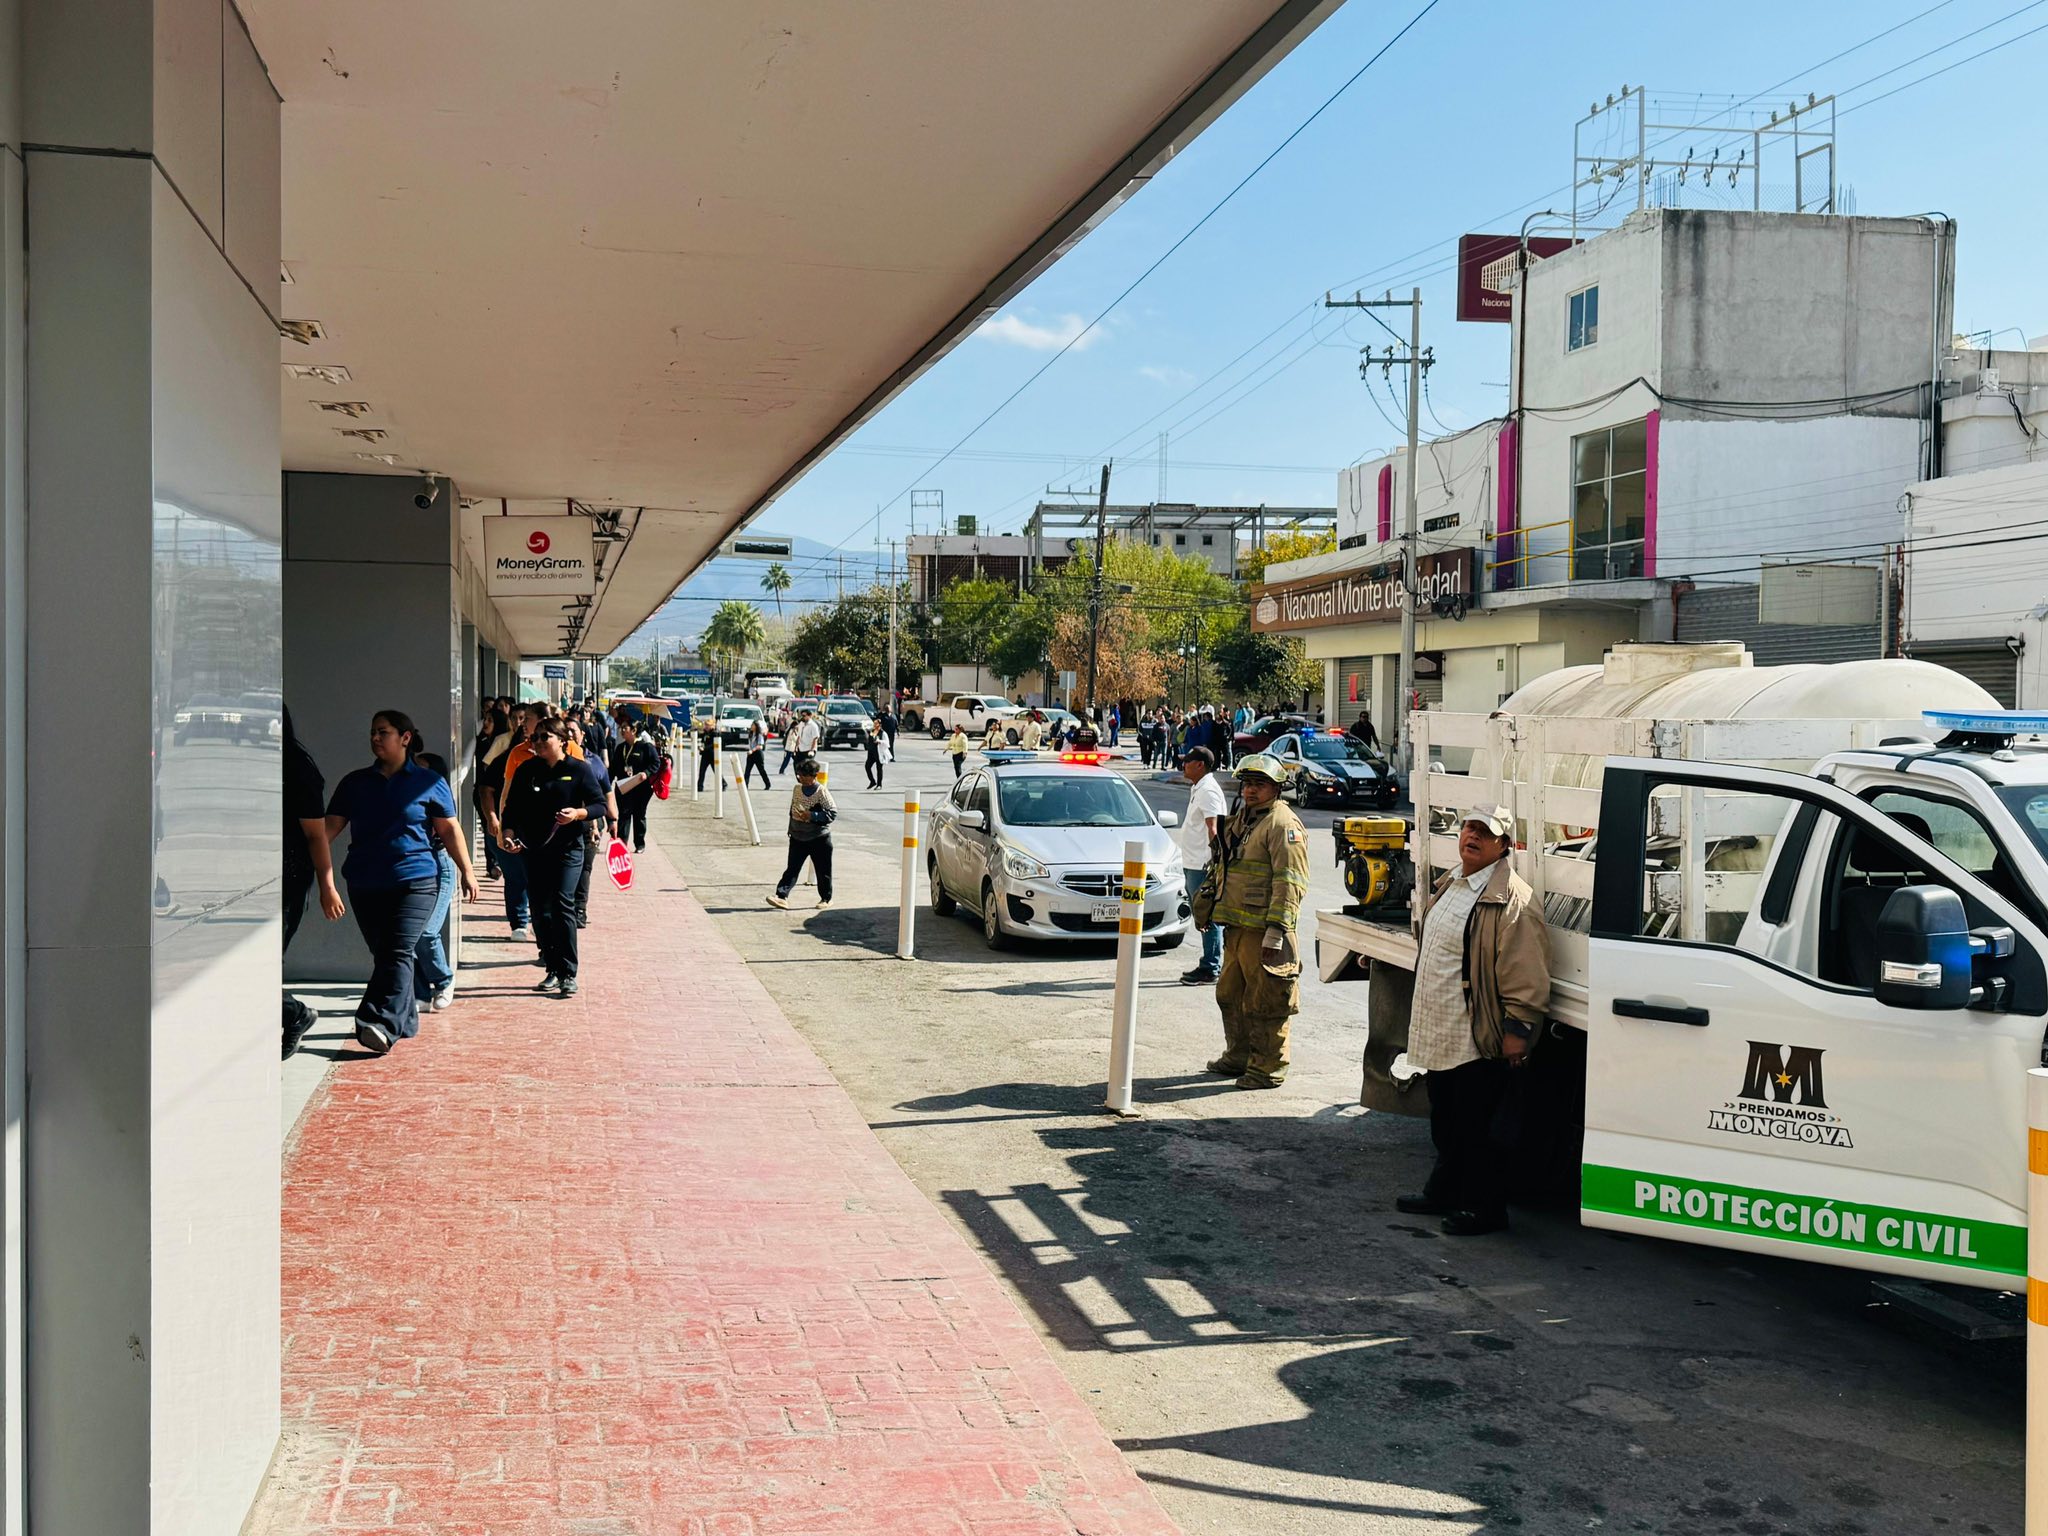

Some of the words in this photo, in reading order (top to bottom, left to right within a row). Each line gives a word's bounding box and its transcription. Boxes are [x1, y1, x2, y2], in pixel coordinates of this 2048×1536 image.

[1282, 581, 1335, 622] Nacional
[1337, 579, 1382, 615] Monte
[1385, 575, 1403, 609] de
[1411, 558, 1461, 606] iedad
[610, 853, 632, 875] STOP
[1707, 1110, 1854, 1148] MONCLOVA
[1738, 1102, 1826, 1122] PRENDAMOS
[1634, 1179, 1867, 1244] PROTECCIÓN
[1876, 1216, 1978, 1260] CIVIL
